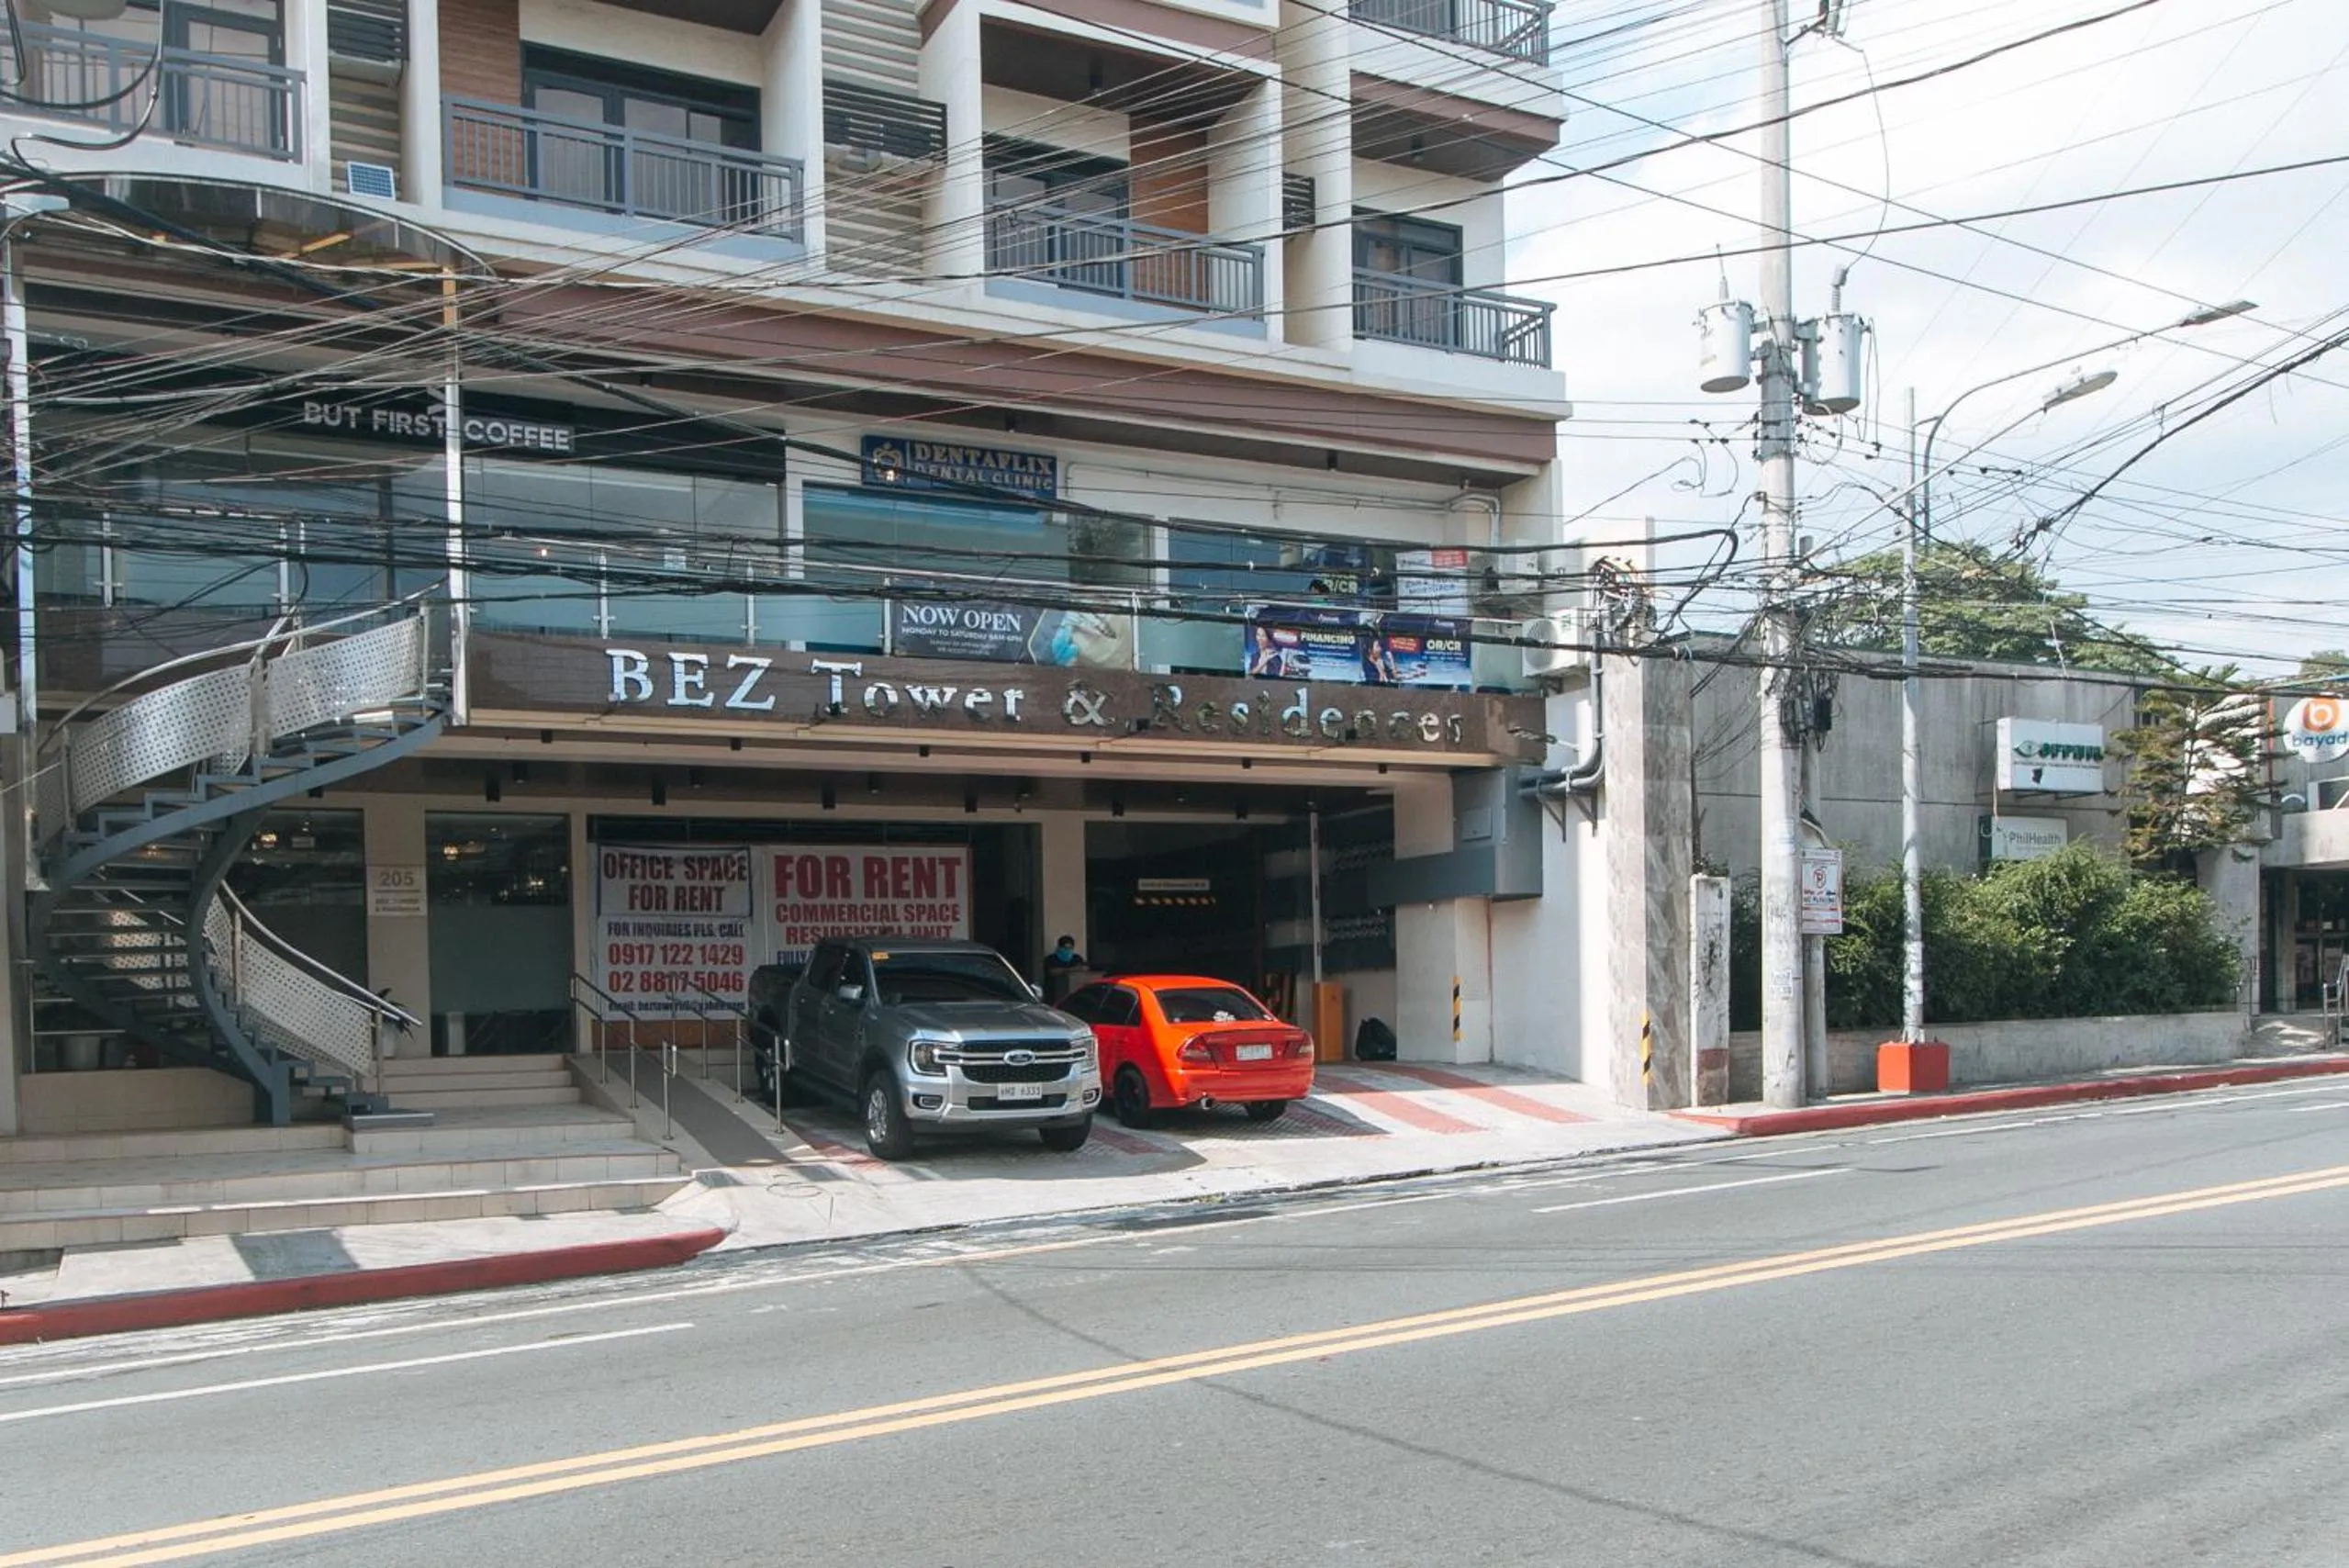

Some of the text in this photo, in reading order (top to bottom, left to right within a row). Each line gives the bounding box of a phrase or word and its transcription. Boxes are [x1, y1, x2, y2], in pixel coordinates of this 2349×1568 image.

[304, 401, 570, 451] BUT FIRST COFFEE
[915, 463, 1052, 489] DENTAL CLINIC
[901, 604, 1021, 632] NOW OPEN
[901, 627, 936, 635] MONDAY
[950, 630, 987, 640] SATURDAY
[1301, 632, 1356, 644] FINANCING
[1426, 638, 1461, 652] OR/CR
[605, 648, 1464, 745] BEZ Tower & Residences
[2292, 731, 2348, 750] bayad
[2009, 831, 2062, 846] PhilHealth
[603, 853, 747, 881] OFFICE SPACE
[774, 855, 961, 899] FOR RENT
[379, 870, 414, 887] 205
[628, 885, 725, 912] FOR RENT
[776, 902, 960, 924] COMMERCIAL SPACE
[608, 922, 630, 936] FOR
[632, 923, 691, 938] INQUIRIES
[719, 923, 744, 938] CALL
[912, 925, 953, 940] UNIT
[609, 943, 744, 966] 0917 122 1429
[609, 969, 633, 992] 02
